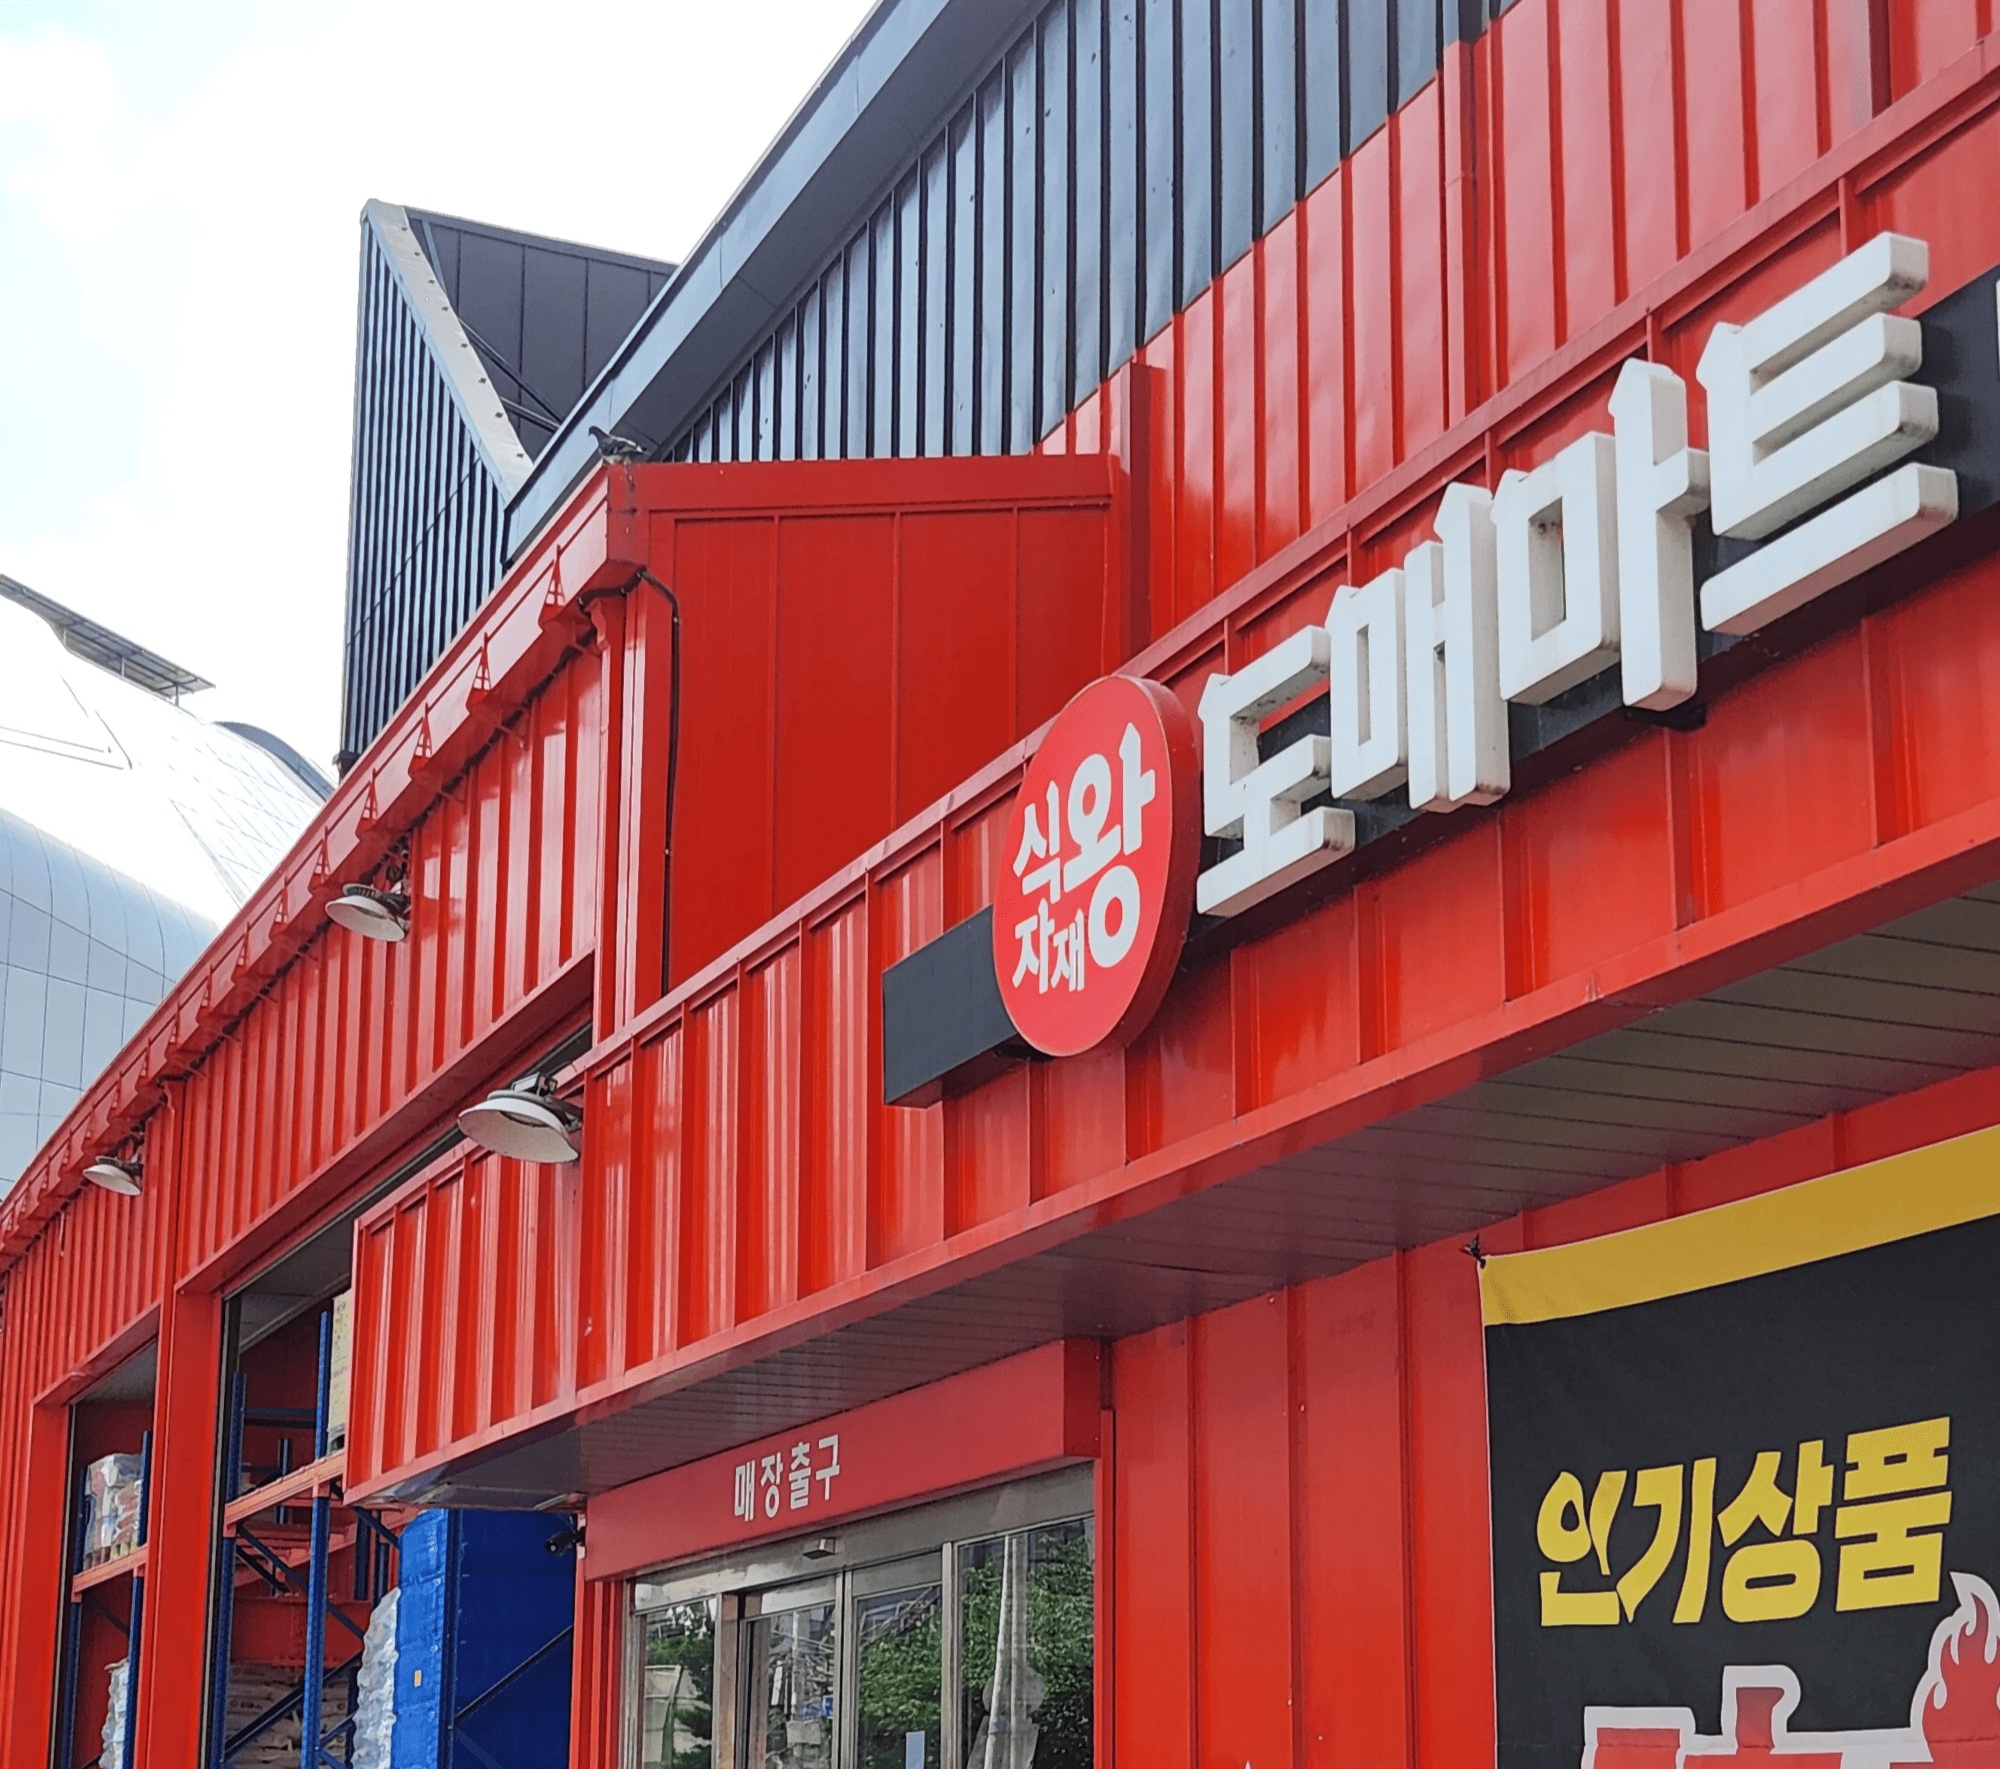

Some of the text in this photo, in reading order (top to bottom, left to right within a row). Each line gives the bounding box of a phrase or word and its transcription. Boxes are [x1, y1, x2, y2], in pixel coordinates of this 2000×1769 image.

[1197, 231, 1959, 917] 도매마트
[734, 1434, 840, 1522] 매장출구
[1537, 1417, 1952, 1627] 인기상품
